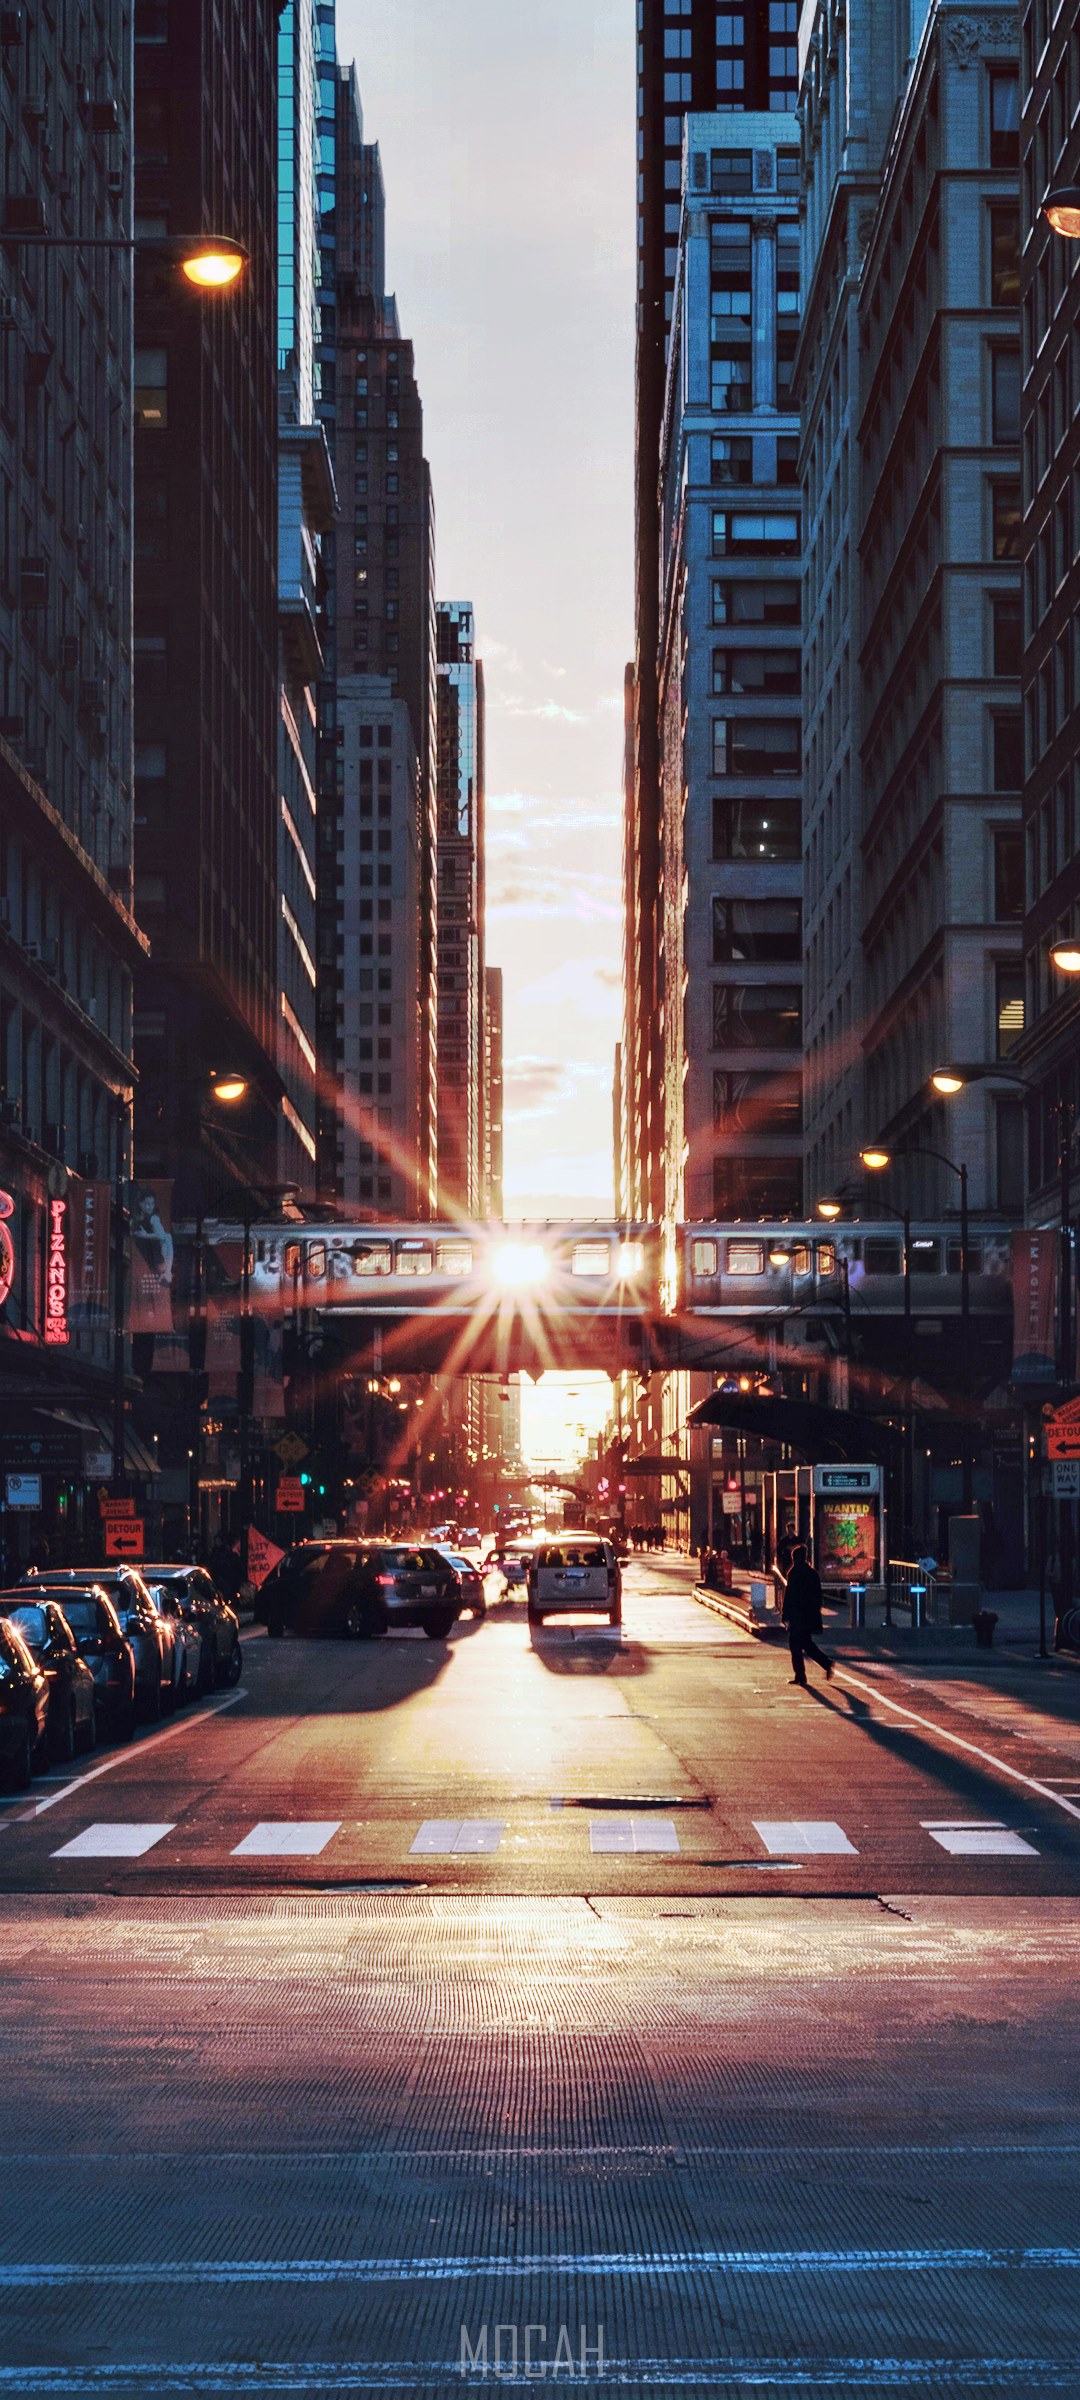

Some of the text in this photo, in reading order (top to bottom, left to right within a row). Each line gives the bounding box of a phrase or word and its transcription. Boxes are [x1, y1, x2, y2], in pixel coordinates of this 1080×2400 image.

[85, 1188, 94, 1272] IMAGINE
[49, 1199, 66, 1317] PIZANOS
[1030, 1237, 1040, 1323] IMAGINE
[1056, 1463, 1077, 1473] ONE
[1056, 1474, 1078, 1483] WAY
[823, 1503, 870, 1513] WANTED
[107, 1524, 141, 1533] DETOUR
[249, 1565, 270, 1573] HEAD
